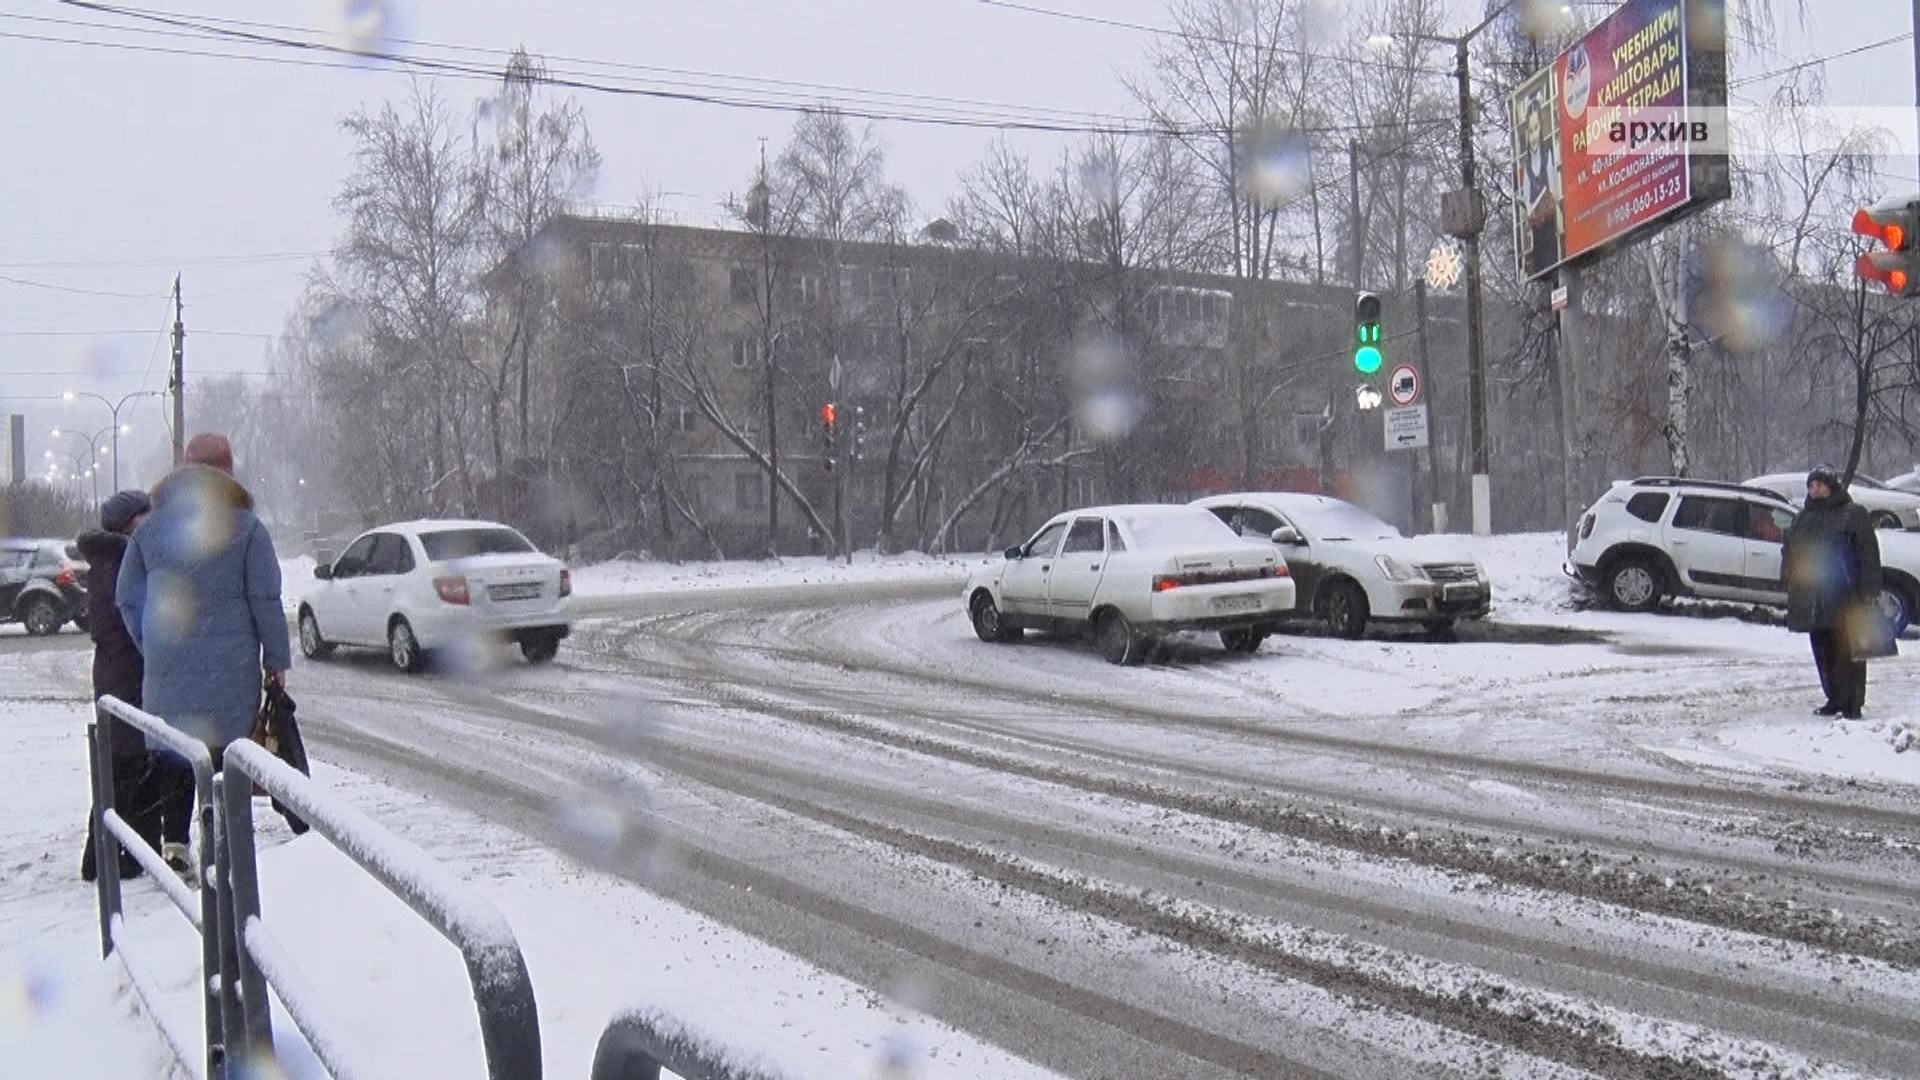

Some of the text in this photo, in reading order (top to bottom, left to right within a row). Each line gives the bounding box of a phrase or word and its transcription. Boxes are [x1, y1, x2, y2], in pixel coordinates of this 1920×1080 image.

[1597, 34, 1679, 111] КАНЦТОВАРЫ
[1612, 5, 1679, 71] УЧЕБНИКИ
[1573, 104, 1621, 153] РАБОЧИЕ
[1626, 64, 1680, 118] ТЕТРАДИ
